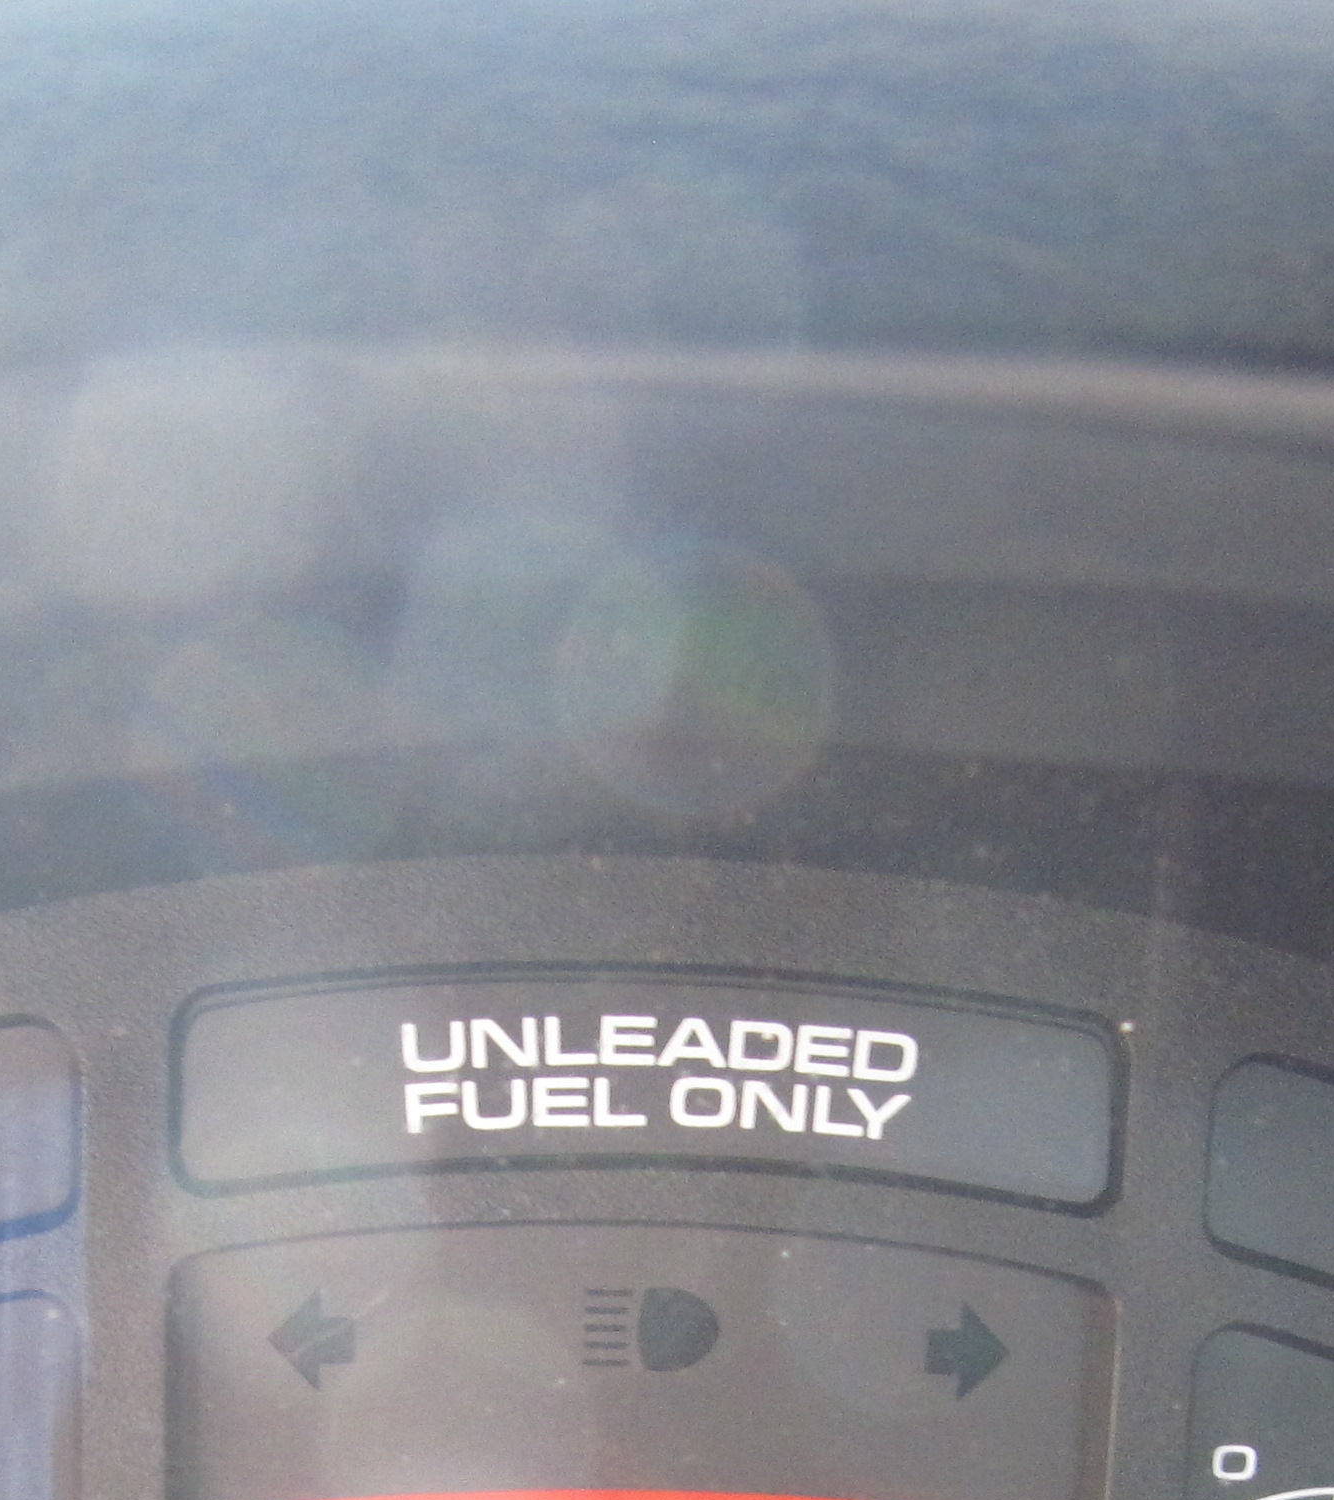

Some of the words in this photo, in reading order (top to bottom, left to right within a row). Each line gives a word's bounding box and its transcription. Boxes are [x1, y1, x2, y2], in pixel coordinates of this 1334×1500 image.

[401, 1015, 918, 1083] UNLEADED
[404, 1077, 648, 1135] FUEL
[669, 1075, 914, 1140] ONLY
[1212, 1444, 1257, 1481] 0
